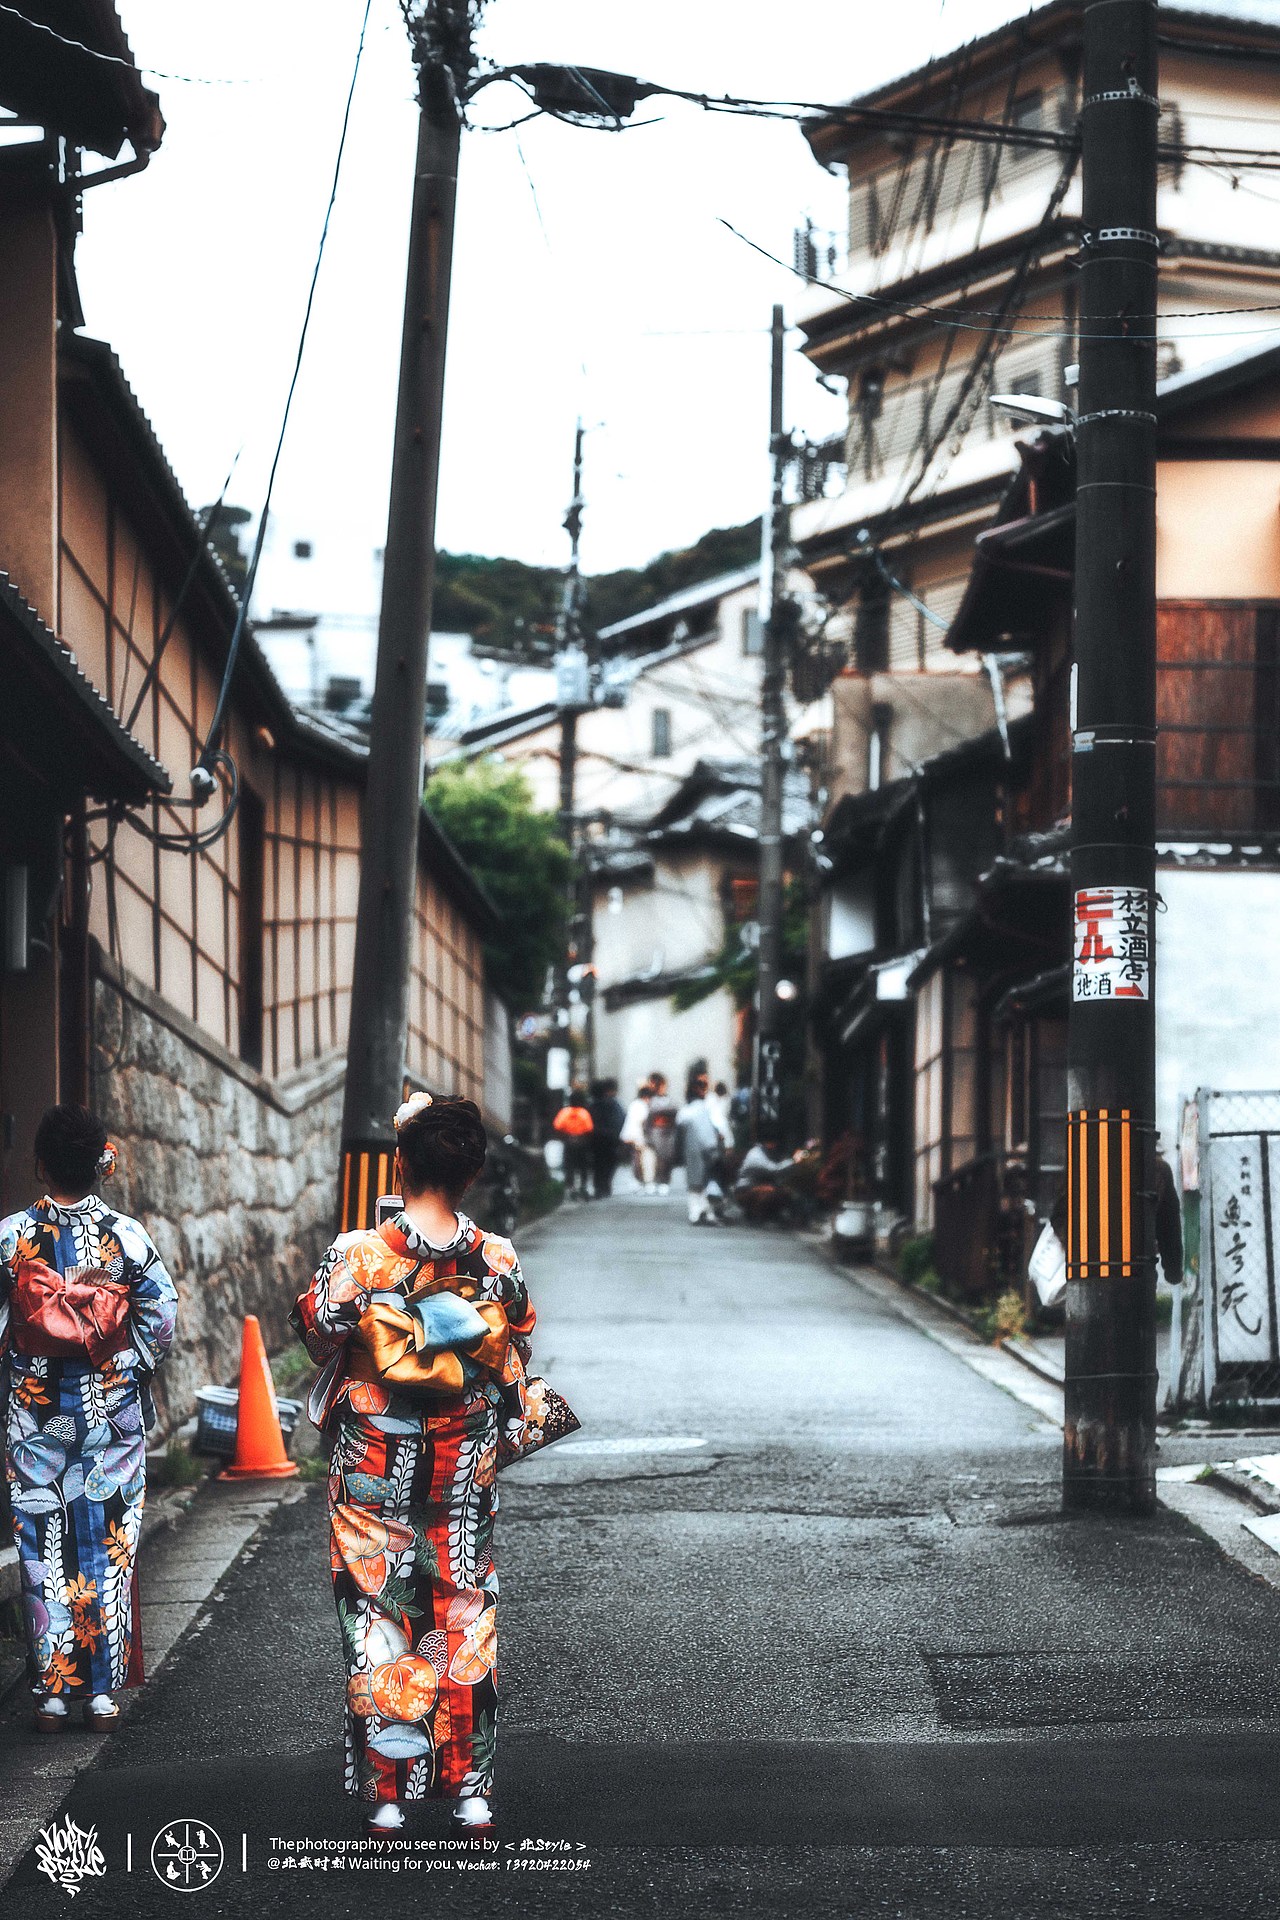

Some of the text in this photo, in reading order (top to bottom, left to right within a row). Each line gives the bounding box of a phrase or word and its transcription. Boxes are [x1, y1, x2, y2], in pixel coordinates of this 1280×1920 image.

[1118, 890, 1147, 981] 杉立酒店
[1077, 972, 1111, 996] 地酒
